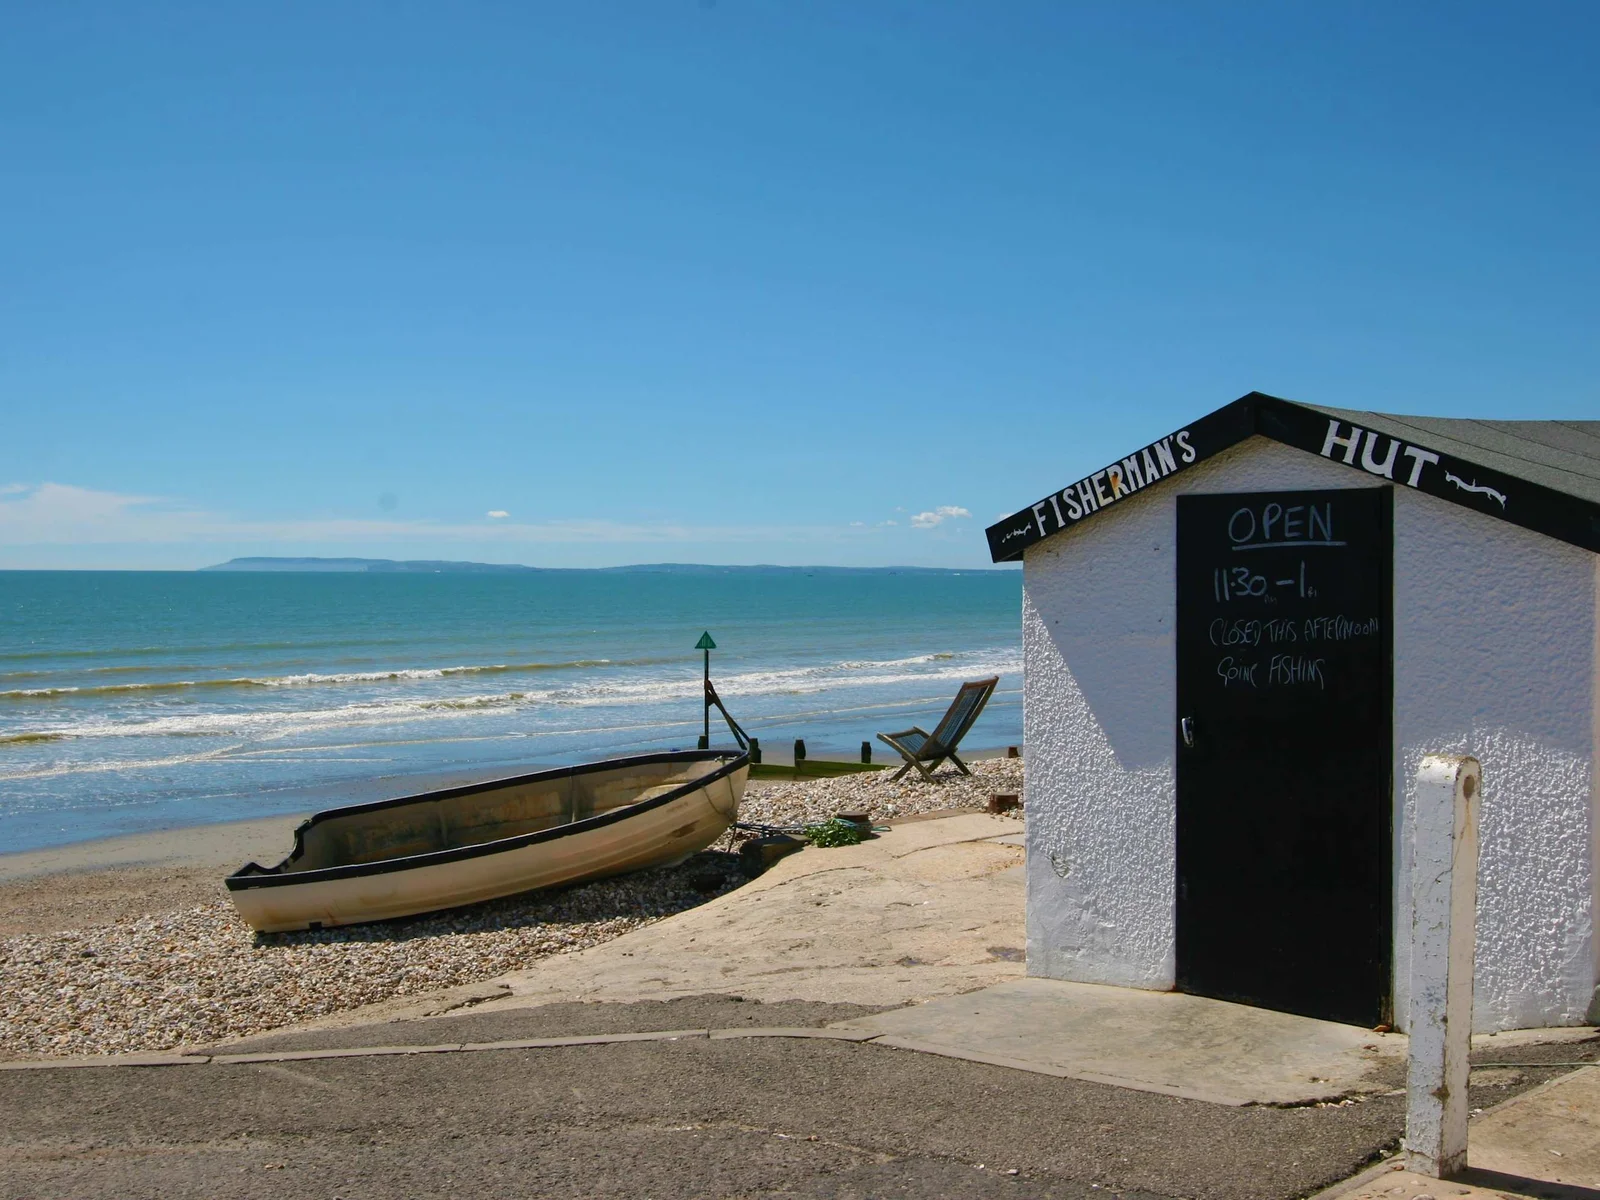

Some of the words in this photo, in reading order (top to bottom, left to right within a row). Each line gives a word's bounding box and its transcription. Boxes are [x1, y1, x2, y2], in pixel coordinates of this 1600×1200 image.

[1032, 430, 1196, 538] FISHERMAN'S
[1320, 419, 1439, 488] HUT
[1228, 503, 1331, 543] OPEN
[1209, 618, 1261, 646] CLOSED
[1263, 618, 1297, 642] THIS
[1304, 614, 1379, 642] AFTERNOON
[1268, 653, 1325, 690] FISHING
